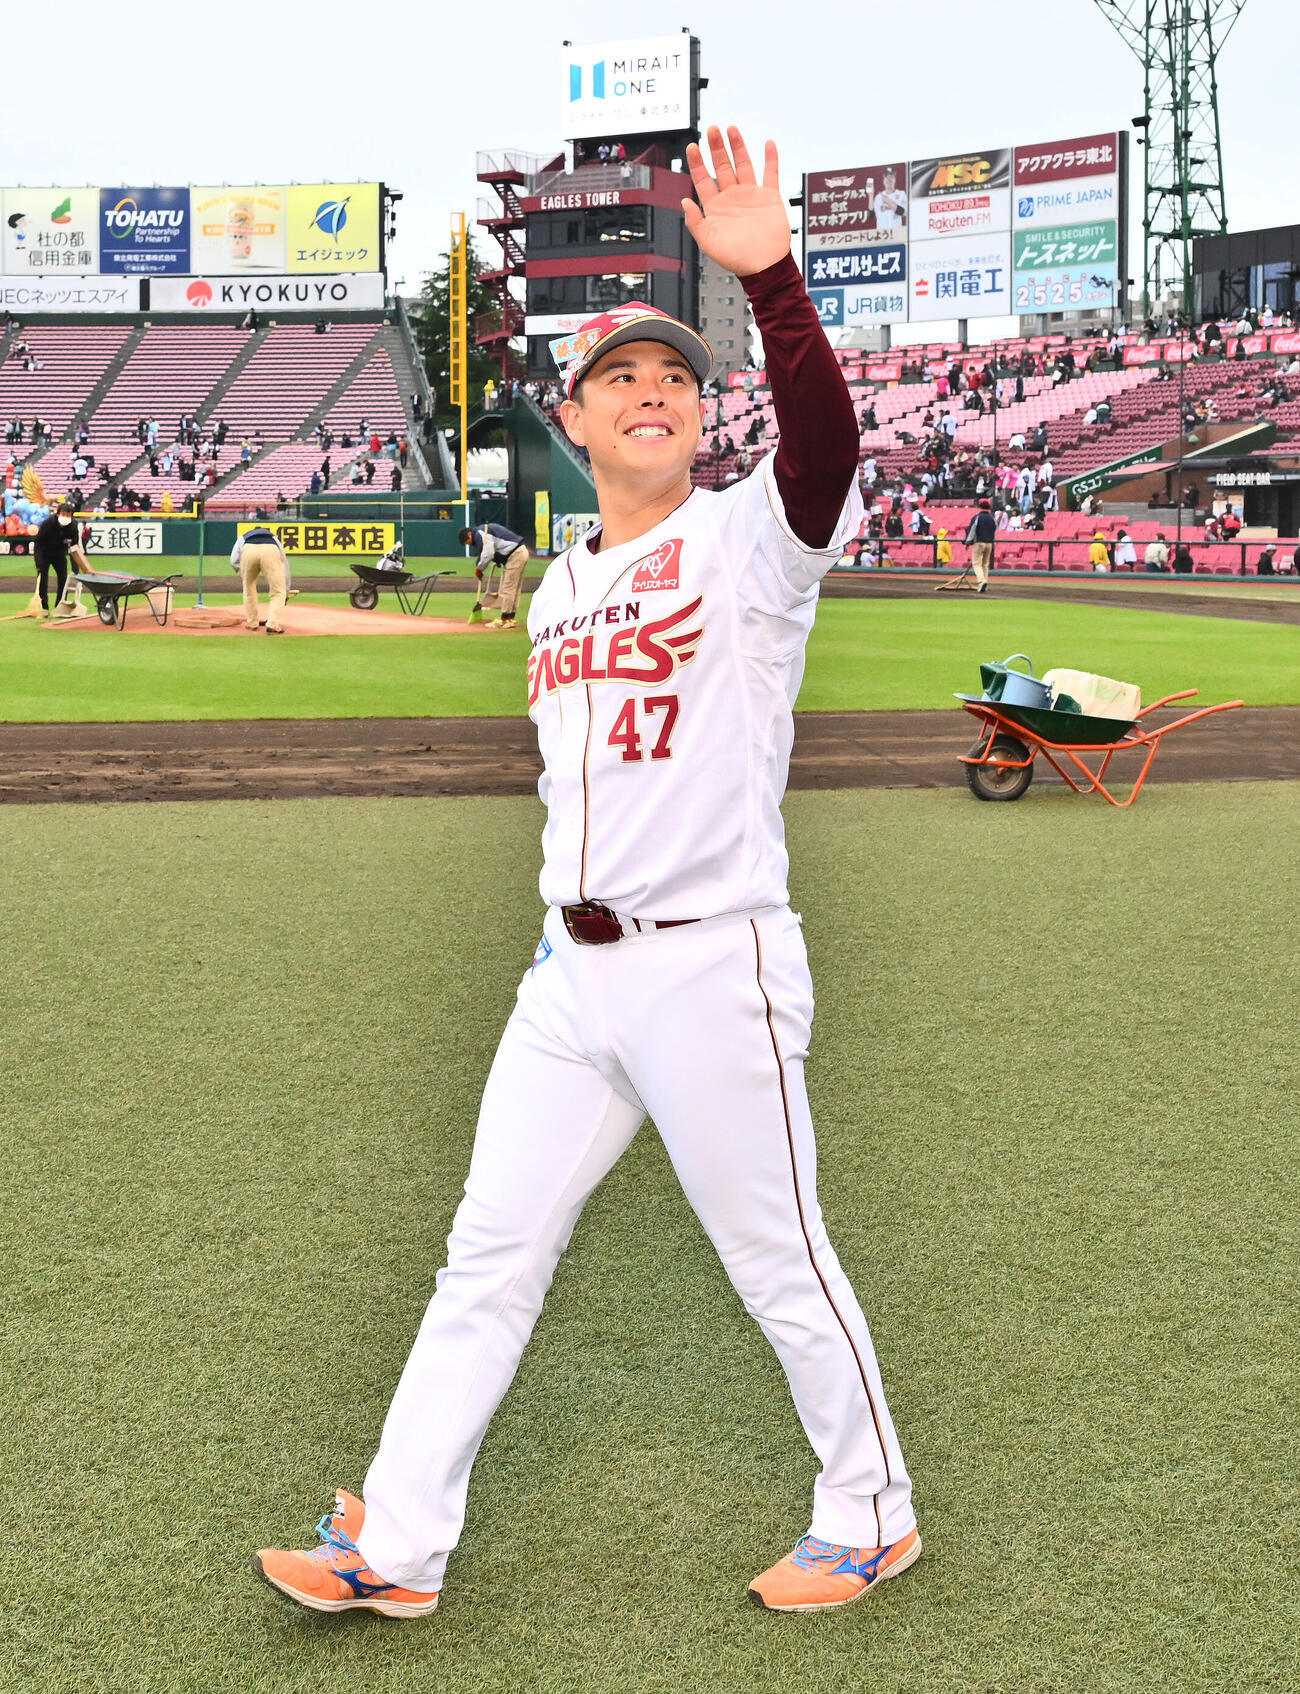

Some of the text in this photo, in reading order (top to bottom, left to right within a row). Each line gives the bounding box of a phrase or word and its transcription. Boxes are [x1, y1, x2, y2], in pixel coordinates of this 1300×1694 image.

[613, 54, 681, 74] MIRAIT
[614, 79, 656, 96] ONE
[1018, 145, 1113, 173] アクアクララ東北
[930, 161, 991, 189] MSC
[541, 191, 620, 210] EAGLES TOWER
[1037, 187, 1113, 208] PRIME JAPAN
[105, 210, 184, 227] TOHATU
[808, 210, 868, 228] スマホアプリ
[38, 231, 85, 247] 杜の都
[135, 227, 180, 237] Partnership
[135, 235, 171, 243] To Hearts
[1025, 231, 1053, 243] SMILE
[1062, 226, 1105, 240] SECURITY
[28, 250, 92, 266] 信用金庫
[296, 248, 368, 261] エイジェック
[1016, 238, 1114, 267] トスネット
[812, 252, 901, 280] 太平ビルサービス
[222, 283, 348, 302] KYOKUYO
[935, 268, 1004, 298] 関電工
[847, 295, 903, 314] JR貨物
[1237, 472, 1254, 486] SEAT
[1256, 472, 1271, 486] BAR
[87, 527, 156, 549] 友銀行
[255, 526, 384, 551] 保田本店
[632, 579, 678, 591] アイリスオーヤマ
[533, 601, 641, 648] RAKUTEN
[528, 594, 704, 708] EAGLES
[607, 694, 681, 762] 47
